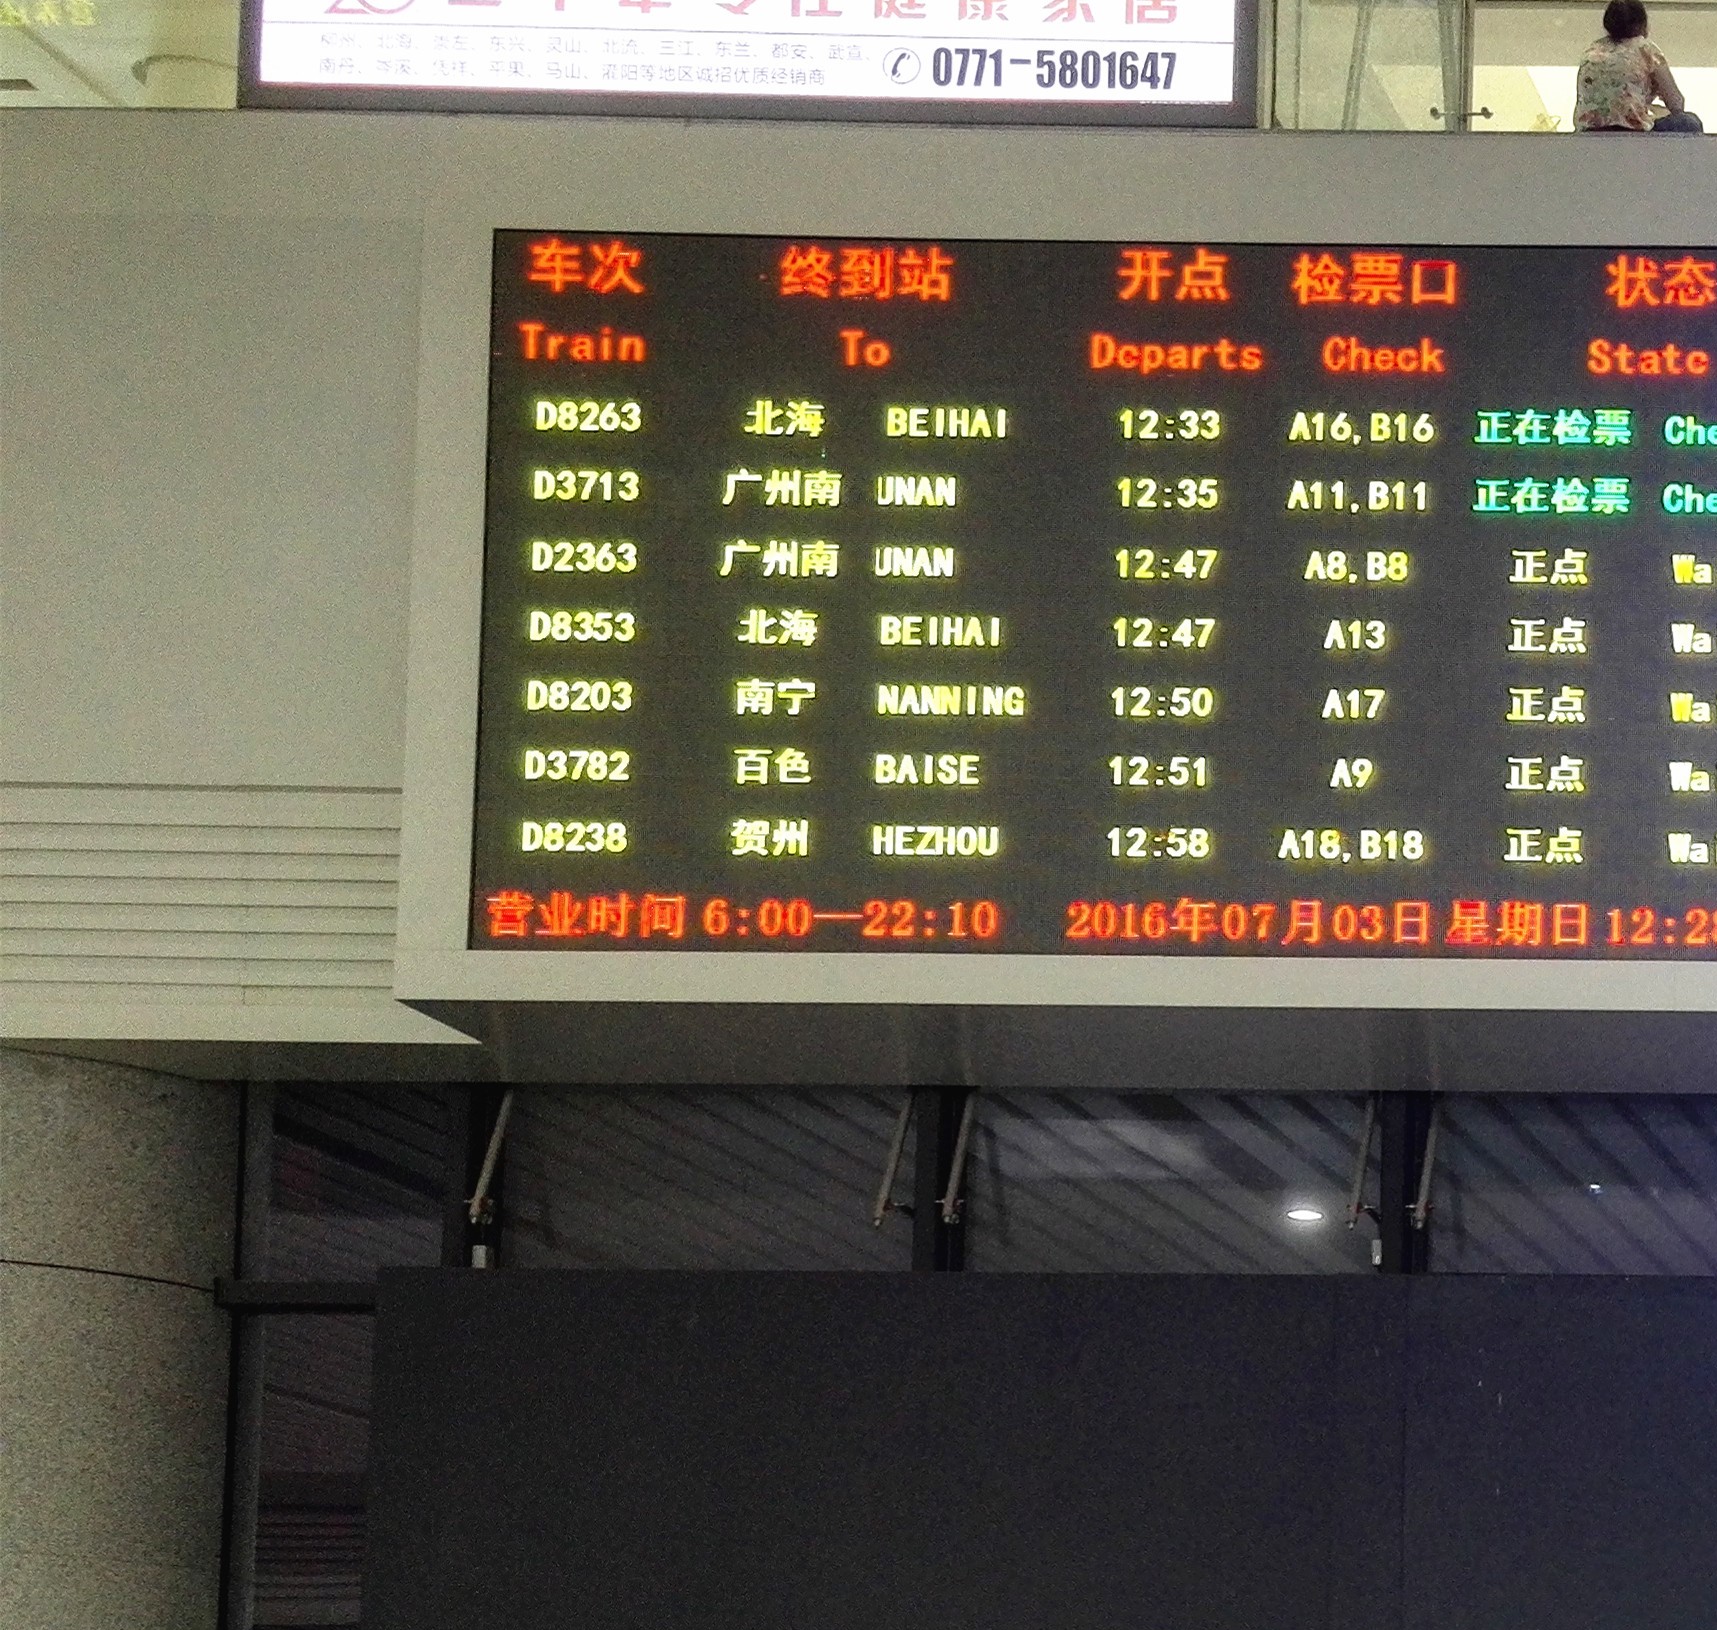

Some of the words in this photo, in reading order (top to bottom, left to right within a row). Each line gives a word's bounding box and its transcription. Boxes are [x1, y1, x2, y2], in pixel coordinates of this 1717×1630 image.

[932, 47, 1177, 90] 0771-5801647
[529, 239, 645, 295] 车次
[781, 246, 955, 302] 终到站
[1119, 249, 1231, 302] 开点
[1292, 253, 1458, 308] 检票口
[520, 323, 646, 363] Train
[841, 330, 892, 368] To
[1323, 336, 1446, 374] Check
[536, 401, 643, 433] D8263
[744, 400, 826, 439] 北海
[887, 407, 1008, 439] BEIHAI
[1120, 410, 1222, 441] 12:33
[1289, 412, 1436, 446] A16,B16
[1475, 409, 1633, 447] 正在检票
[534, 470, 641, 502] D3713
[723, 468, 844, 508] 广州南
[1118, 478, 1219, 510] 12:35
[1288, 481, 1427, 514] A11,B11
[1473, 477, 1632, 516] 正在检票
[532, 541, 638, 574] D2363
[720, 539, 841, 578] 广州南
[1116, 549, 1219, 580] 12:47
[1305, 551, 1409, 585] A8,B8
[1510, 548, 1589, 586] 正点
[530, 611, 637, 643] D8353
[738, 609, 820, 648] 北海
[880, 615, 1001, 648] BEIHAI
[1114, 618, 1217, 649] 12:47
[1324, 620, 1387, 651] A13
[1508, 617, 1588, 655] 正点
[527, 680, 634, 712] D8203
[737, 678, 817, 716] 南宁
[878, 685, 1026, 717] NANNING
[1112, 687, 1215, 718] 12:50
[1322, 689, 1387, 720] A17
[1507, 686, 1587, 724] 正点
[525, 750, 631, 782] D3782
[735, 748, 813, 786] 百色
[875, 754, 981, 786] BAISE
[1110, 756, 1207, 788] 12:51
[1330, 759, 1374, 789] A9
[1506, 756, 1586, 793] 正点
[522, 821, 629, 854] D8238
[731, 819, 810, 858] 贺州
[873, 826, 1001, 858] HEZHOU
[1108, 828, 1211, 859] 12:58
[1278, 830, 1425, 864] A18,B18
[1504, 827, 1585, 865] 正点
[488, 891, 688, 940] 营业时间
[1066, 898, 1432, 947] 2016年07月03日
[1445, 900, 1591, 949] 星期日
